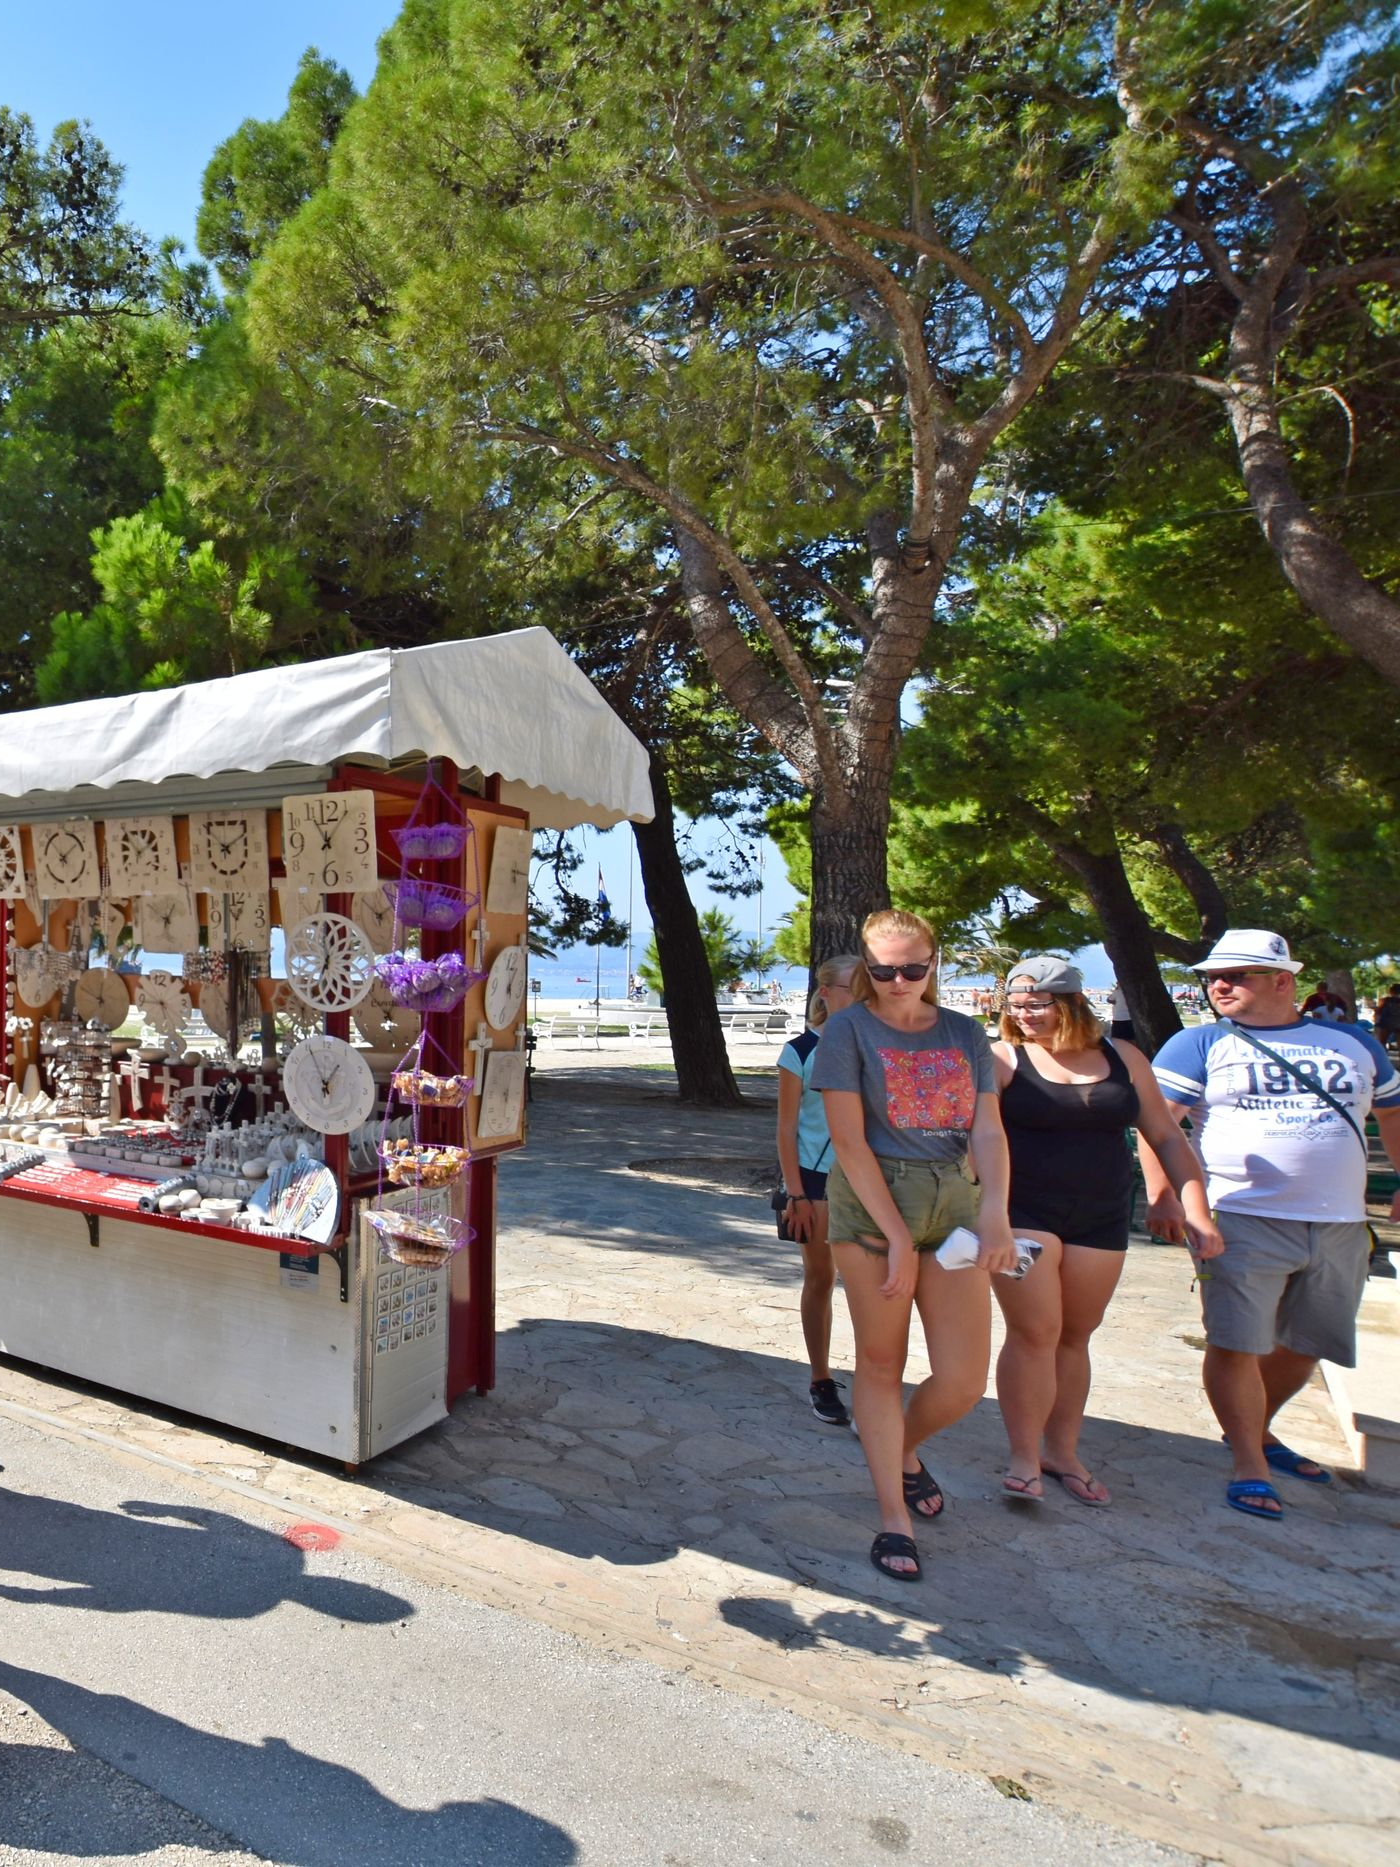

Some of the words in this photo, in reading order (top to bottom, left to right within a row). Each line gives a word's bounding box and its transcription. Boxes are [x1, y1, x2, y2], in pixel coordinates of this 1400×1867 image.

[315, 799, 339, 826] 12
[358, 812, 367, 826] 2
[289, 831, 305, 858] 9
[353, 827, 370, 855] 3
[292, 860, 301, 872] 8
[360, 856, 369, 870] 4
[308, 872, 316, 885] 7
[322, 860, 339, 888] 6
[345, 871, 354, 884] 5
[210, 910, 222, 930] 9
[254, 908, 266, 929] 3
[506, 951, 518, 971] 12
[154, 974, 167, 988] 12
[491, 976, 498, 997] 9
[499, 1006, 506, 1025] 6
[322, 1040, 332, 1049] 12
[1245, 1059, 1353, 1095] 1982
[362, 1087, 369, 1096] 3
[1232, 1097, 1304, 1112] Athletic
[1275, 1113, 1314, 1125] Sport
